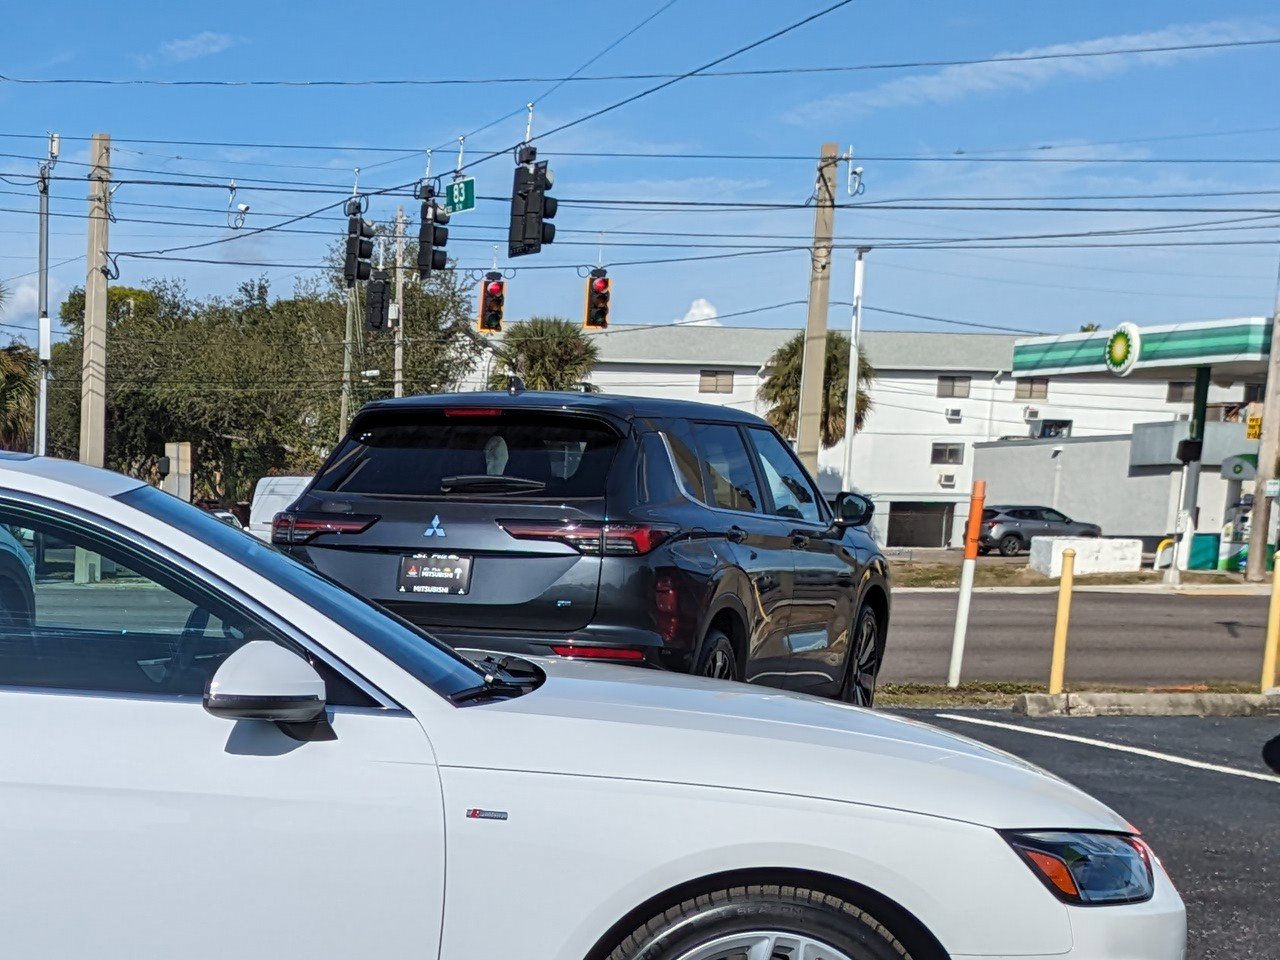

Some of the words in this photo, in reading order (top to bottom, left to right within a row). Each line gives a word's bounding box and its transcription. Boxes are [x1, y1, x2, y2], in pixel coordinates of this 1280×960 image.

[453, 183, 465, 203] 83
[422, 571, 454, 579] MITSUBISHI
[413, 585, 449, 594] MITSUBISHI
